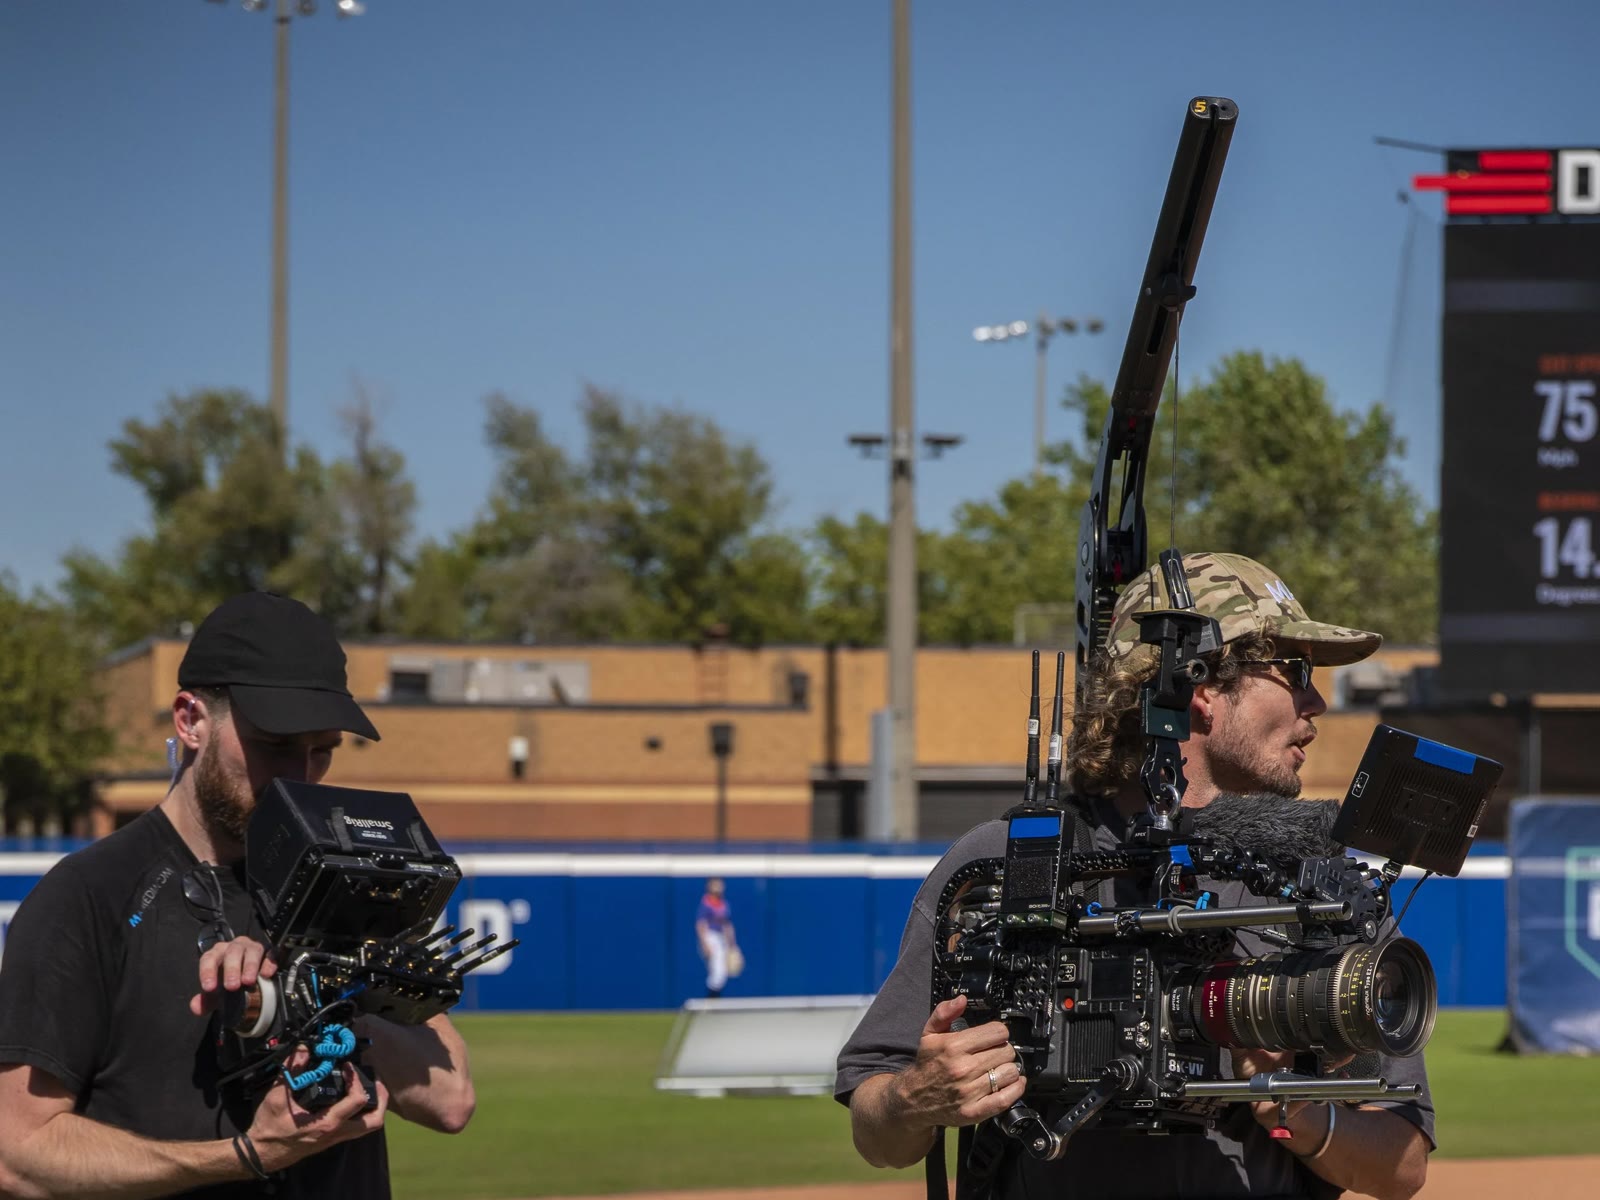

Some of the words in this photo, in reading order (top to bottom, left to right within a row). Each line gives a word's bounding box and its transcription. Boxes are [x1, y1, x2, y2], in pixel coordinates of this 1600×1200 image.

[1194, 101, 1206, 113] 5
[1534, 381, 1598, 442] 75
[343, 815, 394, 831] SmallRig
[1168, 1059, 1204, 1076] 8K-VV
